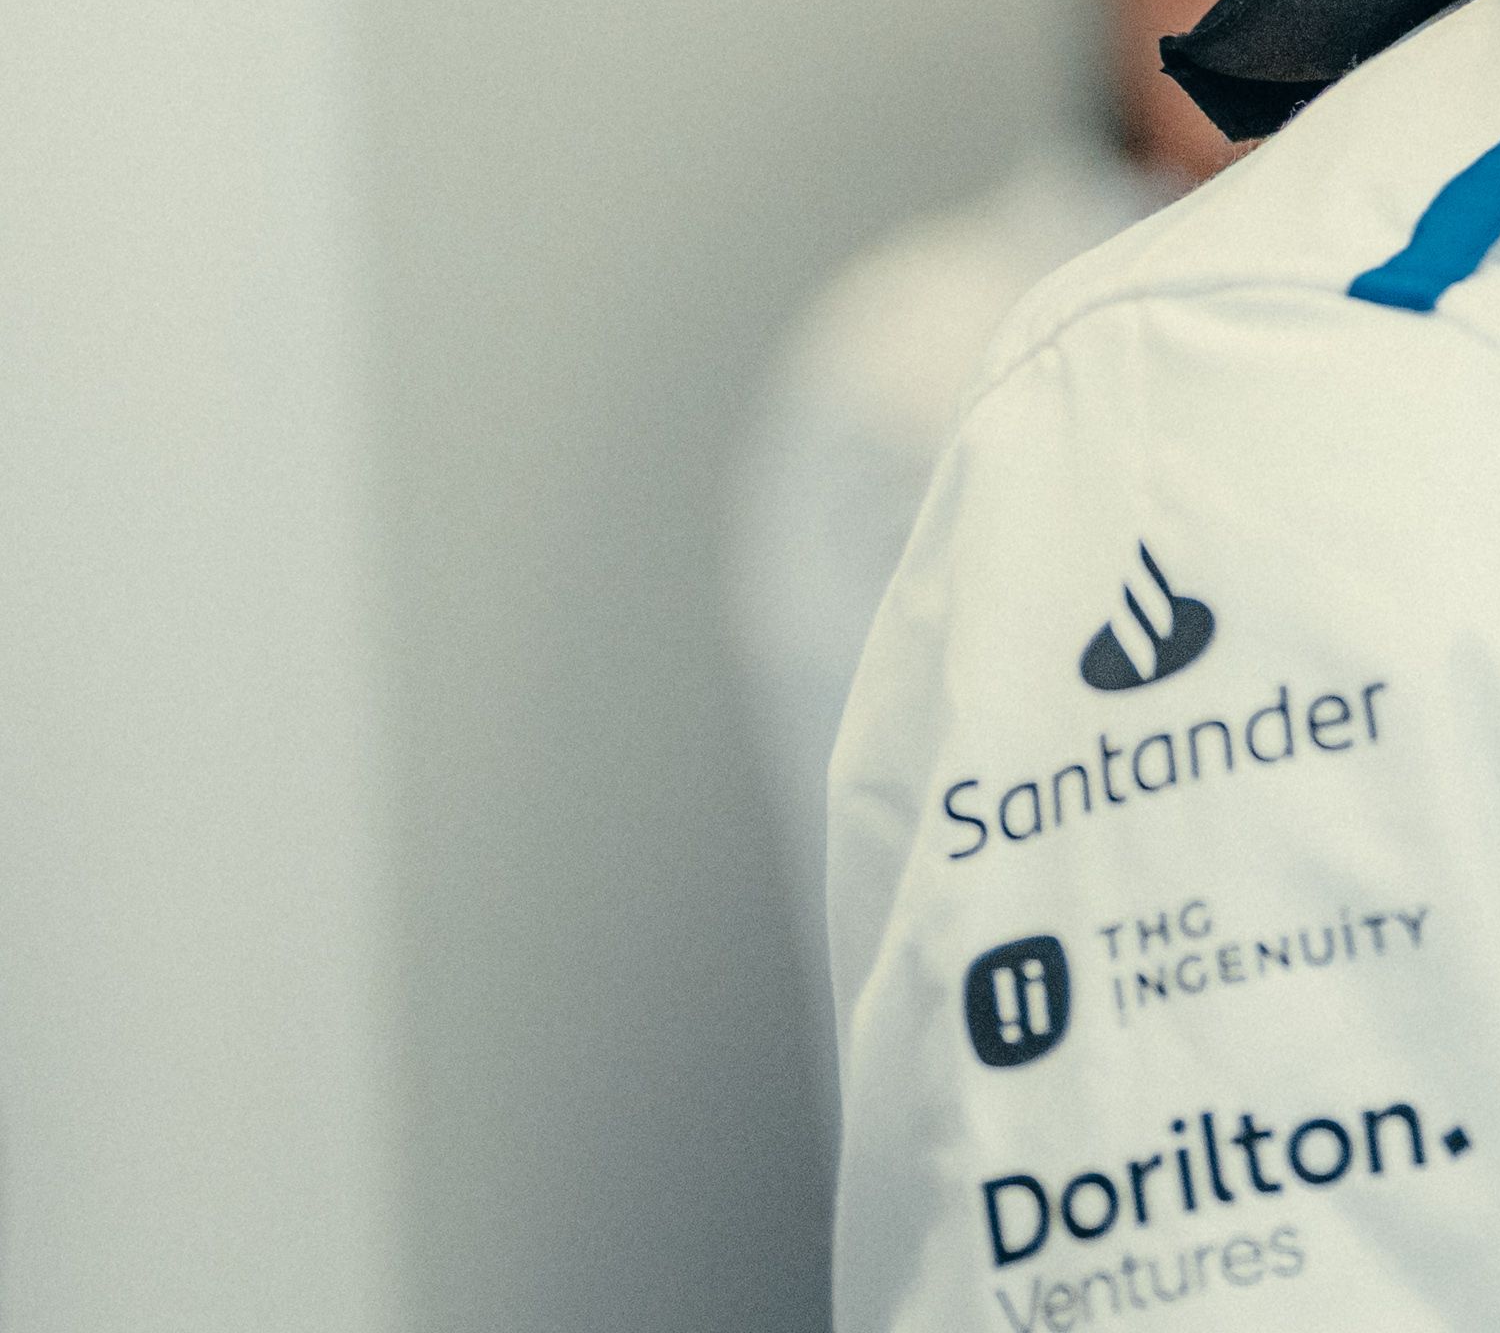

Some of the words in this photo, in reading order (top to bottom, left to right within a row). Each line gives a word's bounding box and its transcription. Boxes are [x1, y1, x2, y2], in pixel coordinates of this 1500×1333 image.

[942, 680, 1388, 862] Santander
[1112, 904, 1430, 1029] INGENUITY
[995, 1225, 1307, 1333] Ventures
